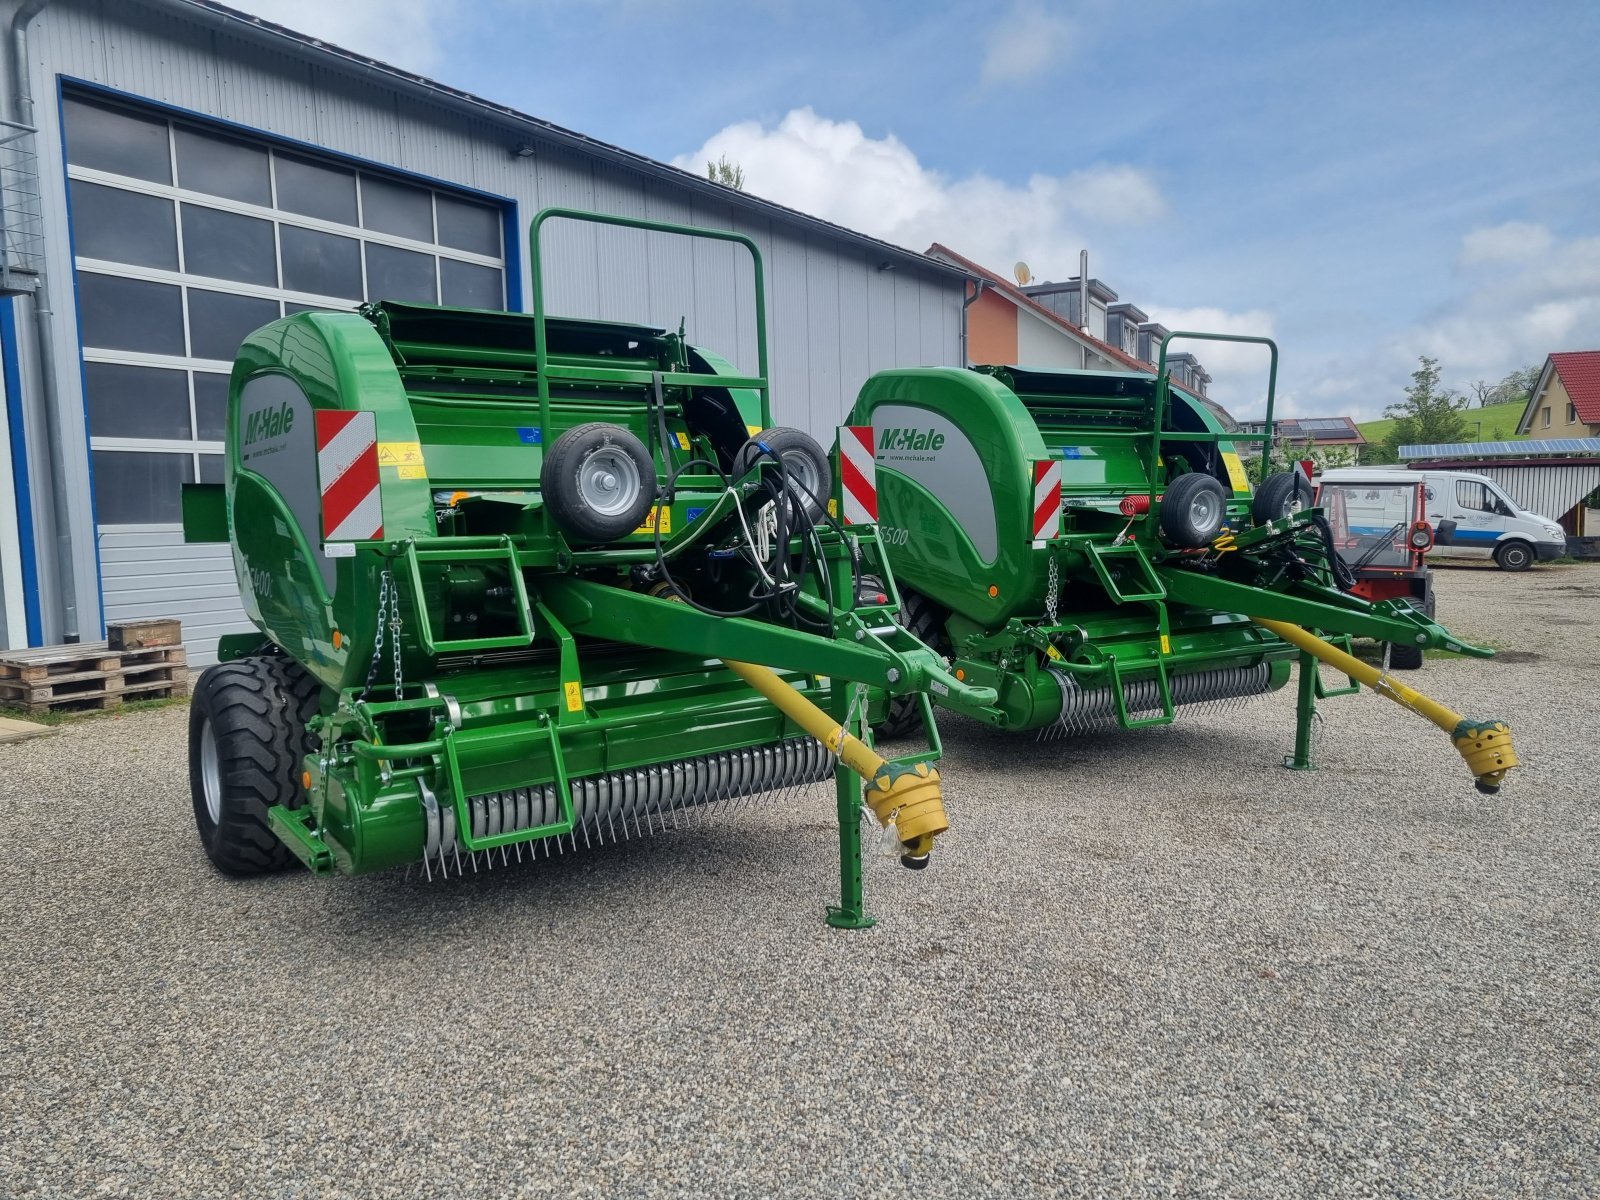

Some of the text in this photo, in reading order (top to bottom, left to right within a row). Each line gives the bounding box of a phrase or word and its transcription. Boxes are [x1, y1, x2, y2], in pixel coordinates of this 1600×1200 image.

[244, 401, 294, 445] McHale
[878, 428, 945, 451] McHale
[889, 454, 936, 462] www.mchale.net
